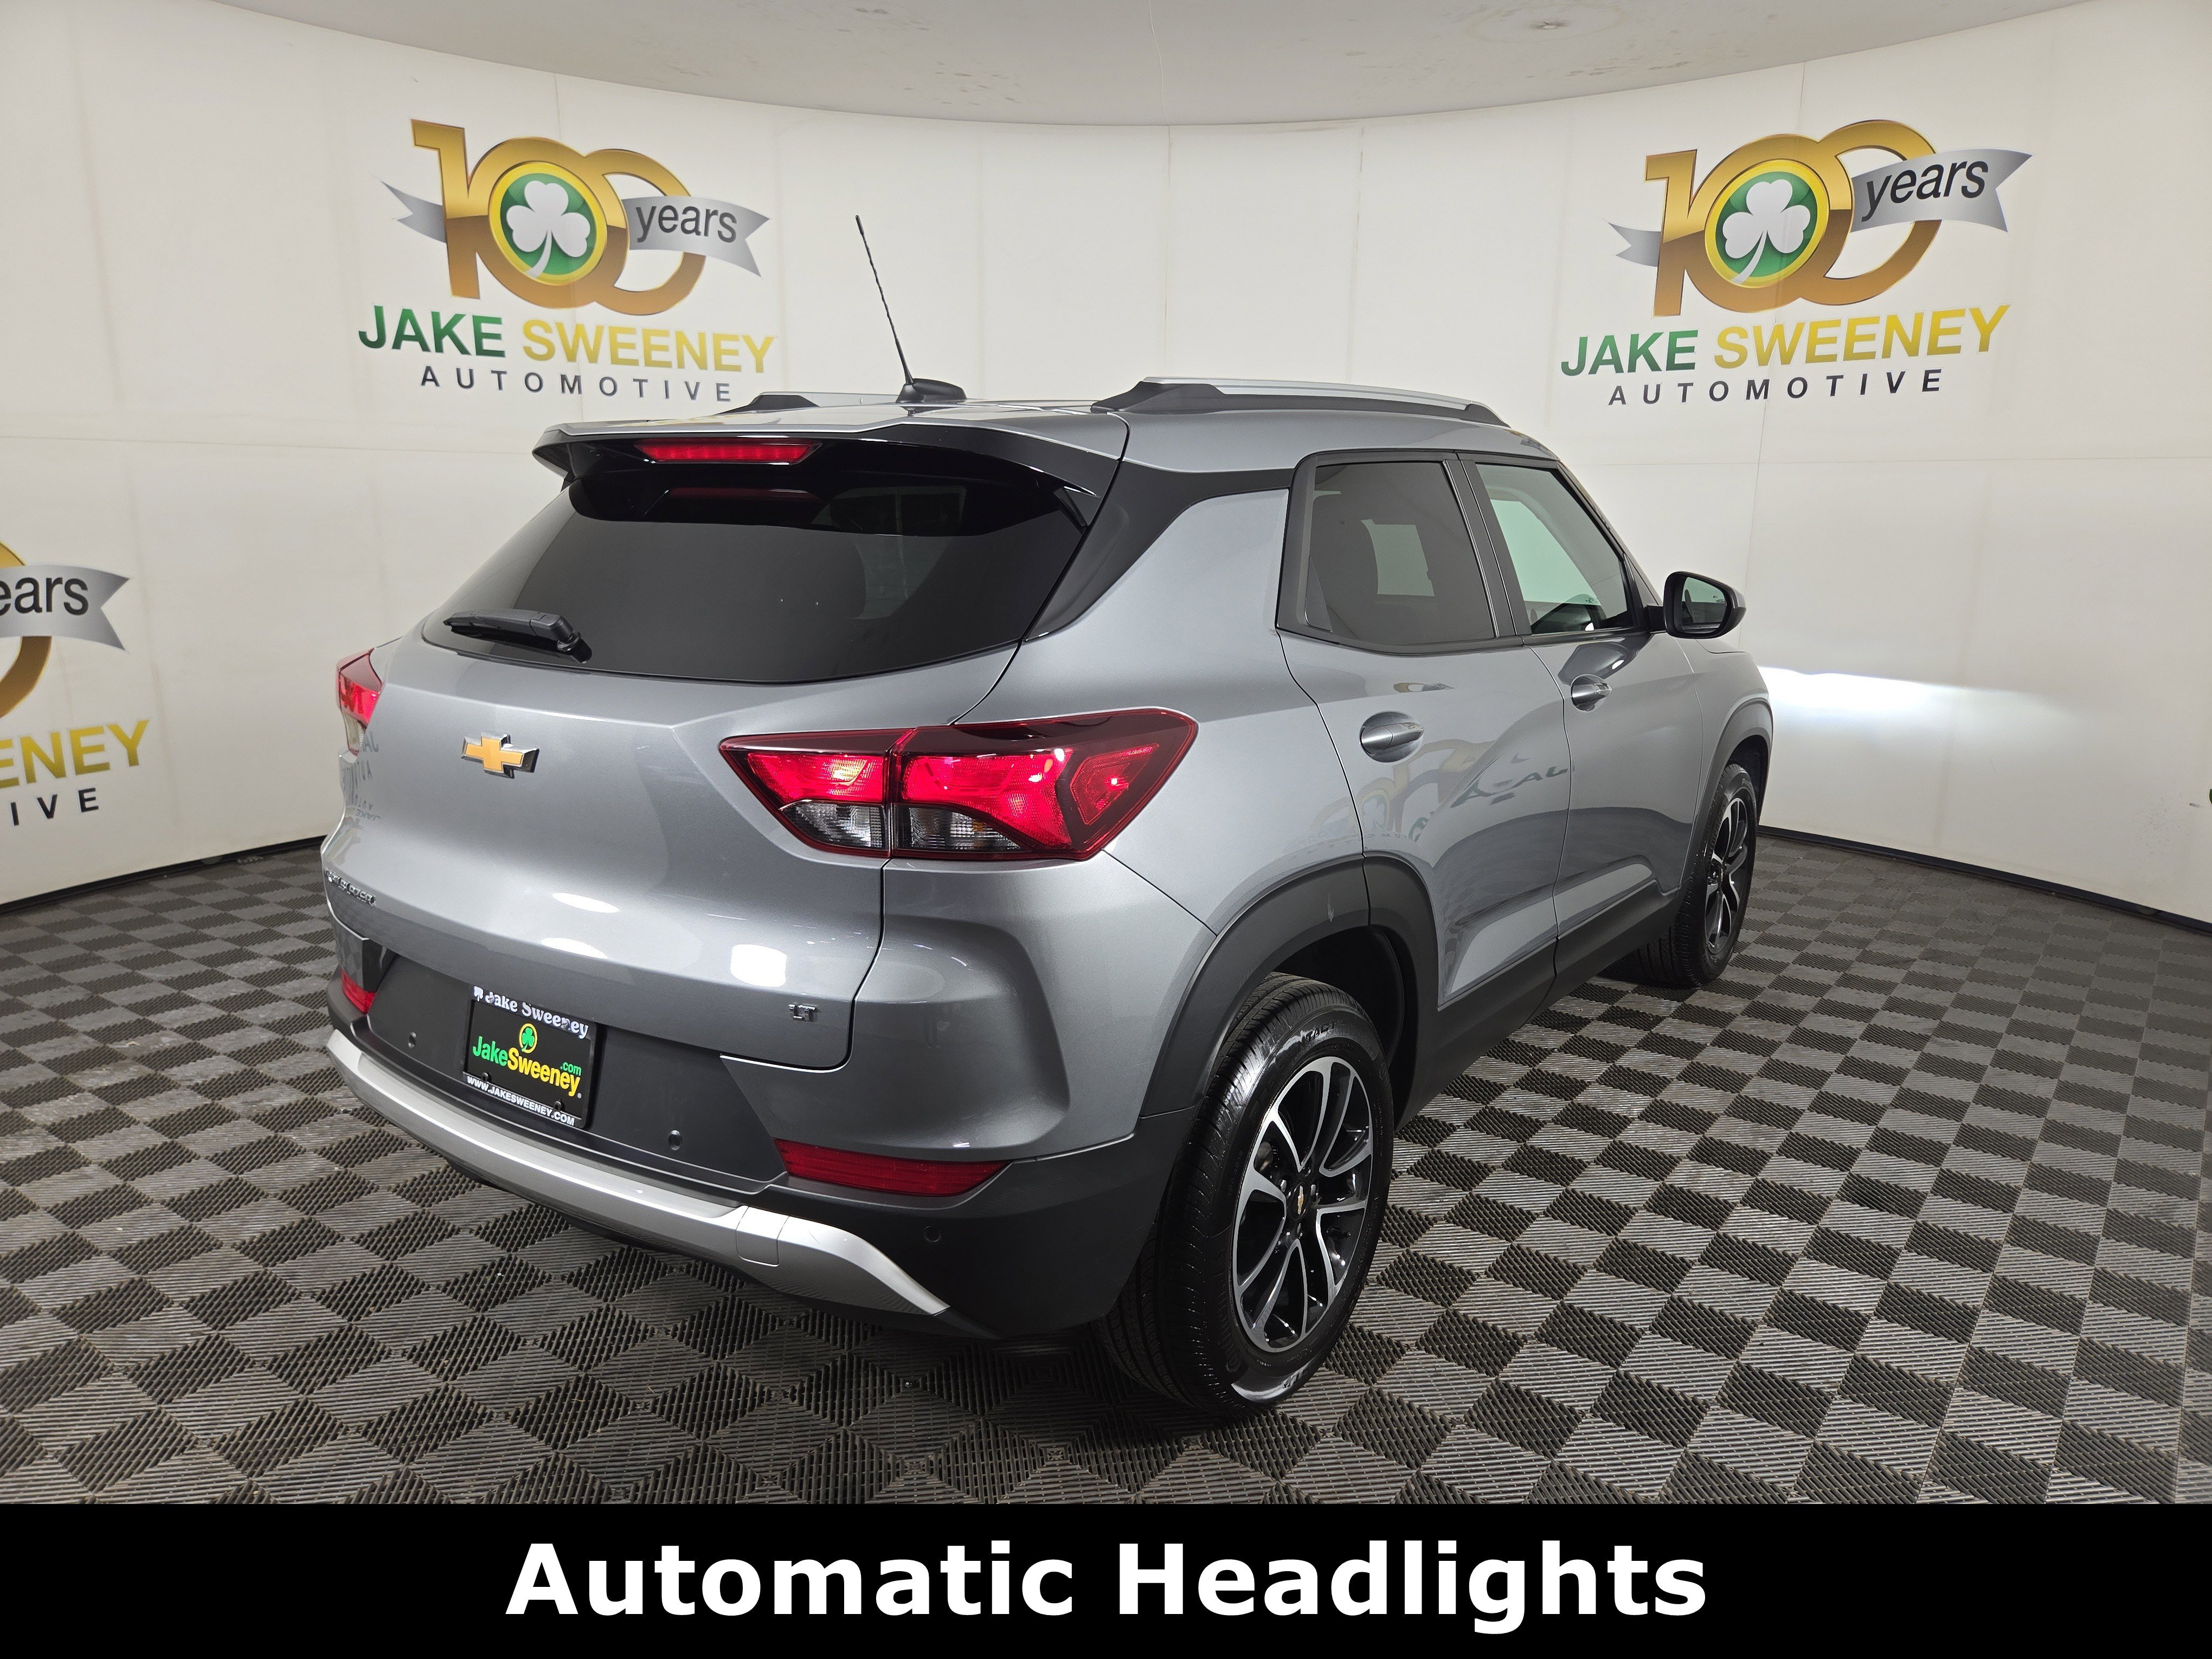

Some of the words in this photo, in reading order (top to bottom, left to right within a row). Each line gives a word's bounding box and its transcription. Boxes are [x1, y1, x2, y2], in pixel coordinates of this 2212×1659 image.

[410, 119, 706, 316] 100
[1644, 119, 1943, 317] 100
[1861, 160, 1989, 222] years
[635, 204, 737, 243] years
[358, 305, 505, 358] JAKE
[522, 319, 775, 373] SWEENEY
[1561, 329, 1699, 376] JAKE
[1714, 305, 2010, 369] SWEENEY
[420, 365, 731, 402] AUTOMOTIVE
[1608, 369, 1942, 406] AUTOMOTIVE
[485, 992, 517, 1012] Jake
[522, 1002, 589, 1039] Sweeney
[467, 1076, 575, 1126] WWW.JAKESWEENEY.COM
